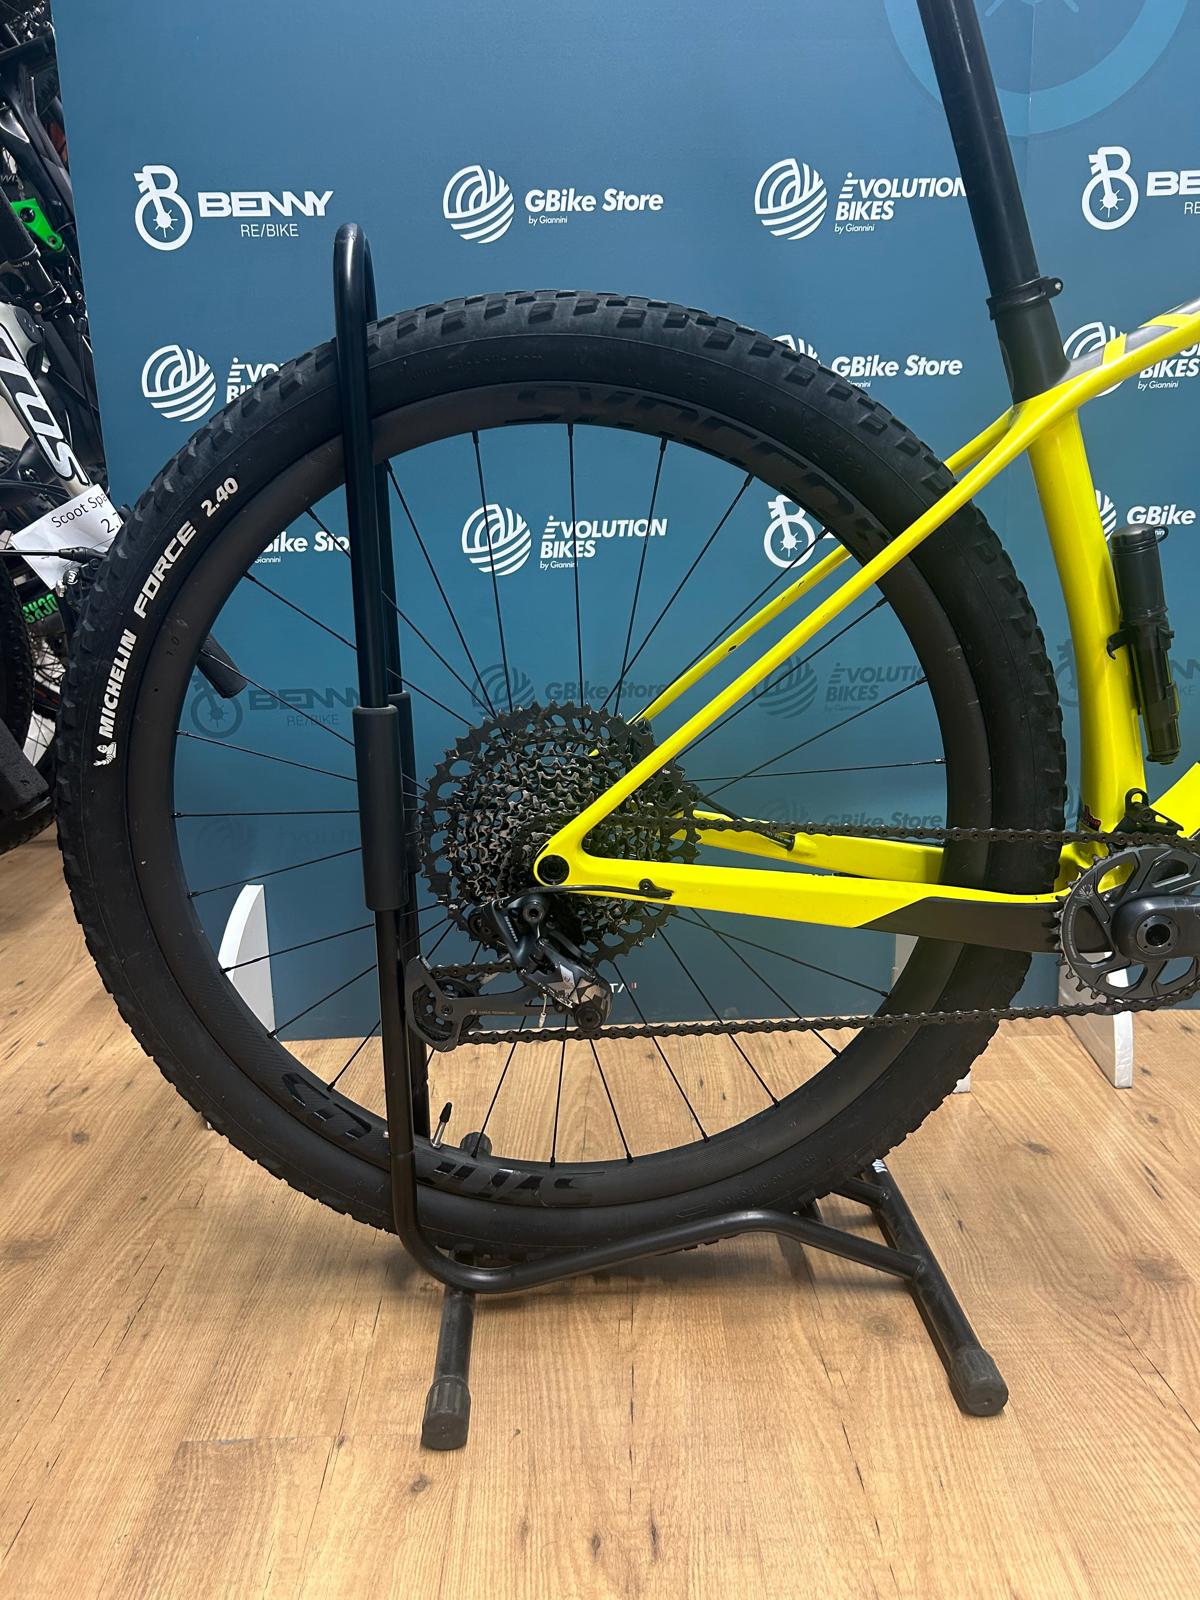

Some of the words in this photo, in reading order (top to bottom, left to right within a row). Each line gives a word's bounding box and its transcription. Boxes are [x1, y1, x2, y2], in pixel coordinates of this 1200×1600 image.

[197, 190, 334, 218] BENNY
[524, 187, 597, 213] GBike
[601, 187, 664, 211] Store
[835, 200, 895, 222] BIKES
[240, 223, 299, 238] RE/BIKE
[528, 215, 538, 227] by
[539, 215, 568, 225] Giannini
[834, 223, 845, 234] by
[845, 223, 875, 233] Giannini
[831, 354, 900, 378] GBike
[904, 354, 963, 376] Store
[1137, 380, 1148, 392] by
[1148, 380, 1179, 390] Giannini
[201, 477, 239, 518] 2.40
[51, 504, 88, 528] Scoot
[1126, 504, 1196, 526] GBike
[540, 540, 596, 559] BIKES
[134, 520, 197, 619] FORCE
[540, 560, 549, 571] by
[98, 628, 137, 739] MICHELIN
[826, 685, 879, 702] BIKES
